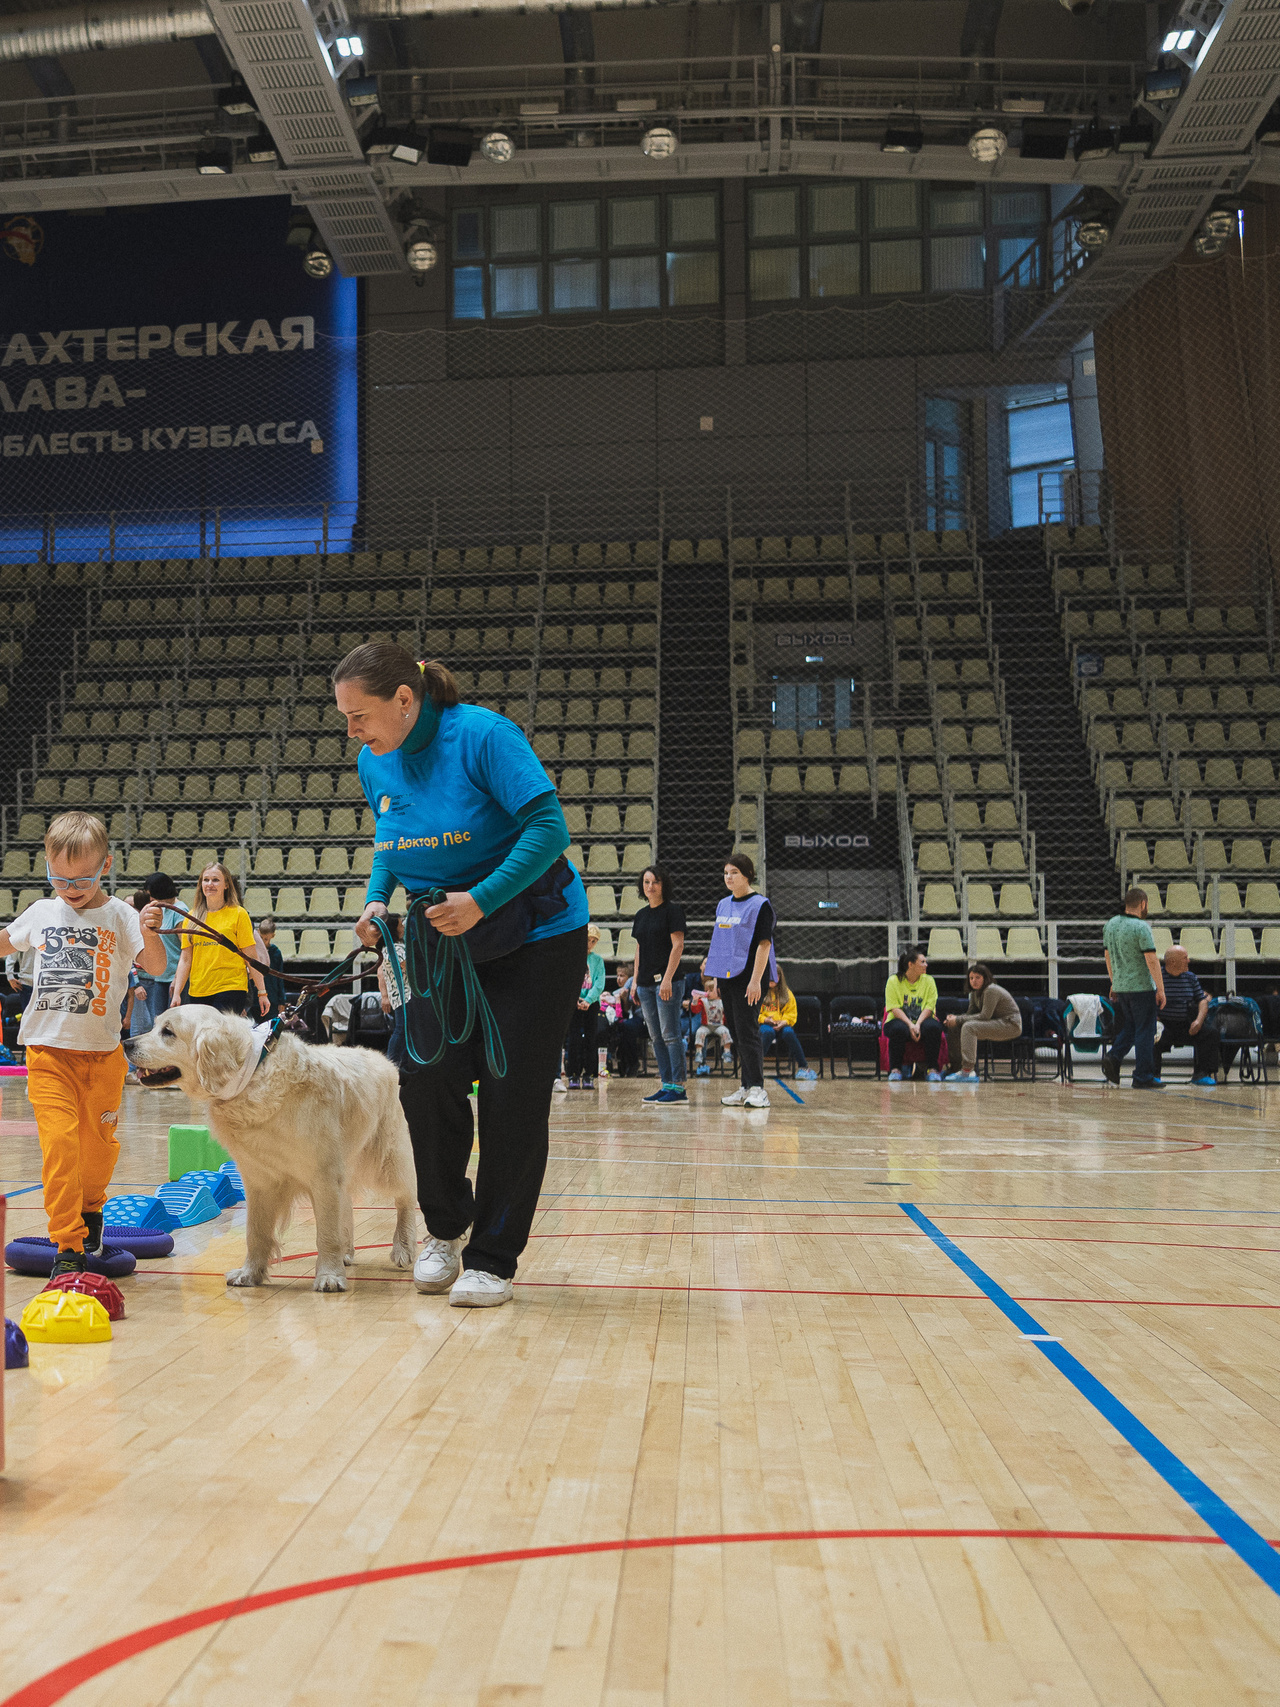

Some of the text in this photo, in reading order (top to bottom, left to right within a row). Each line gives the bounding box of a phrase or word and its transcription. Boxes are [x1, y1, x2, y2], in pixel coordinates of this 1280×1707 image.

[141, 420, 321, 451] КУЗБАССА
[777, 633, 853, 647] ВЫХОД
[397, 836, 439, 850] Доктор
[443, 830, 471, 846] Пёс
[784, 834, 870, 848] ВЫХОД
[91, 952, 112, 1016] BOYS
